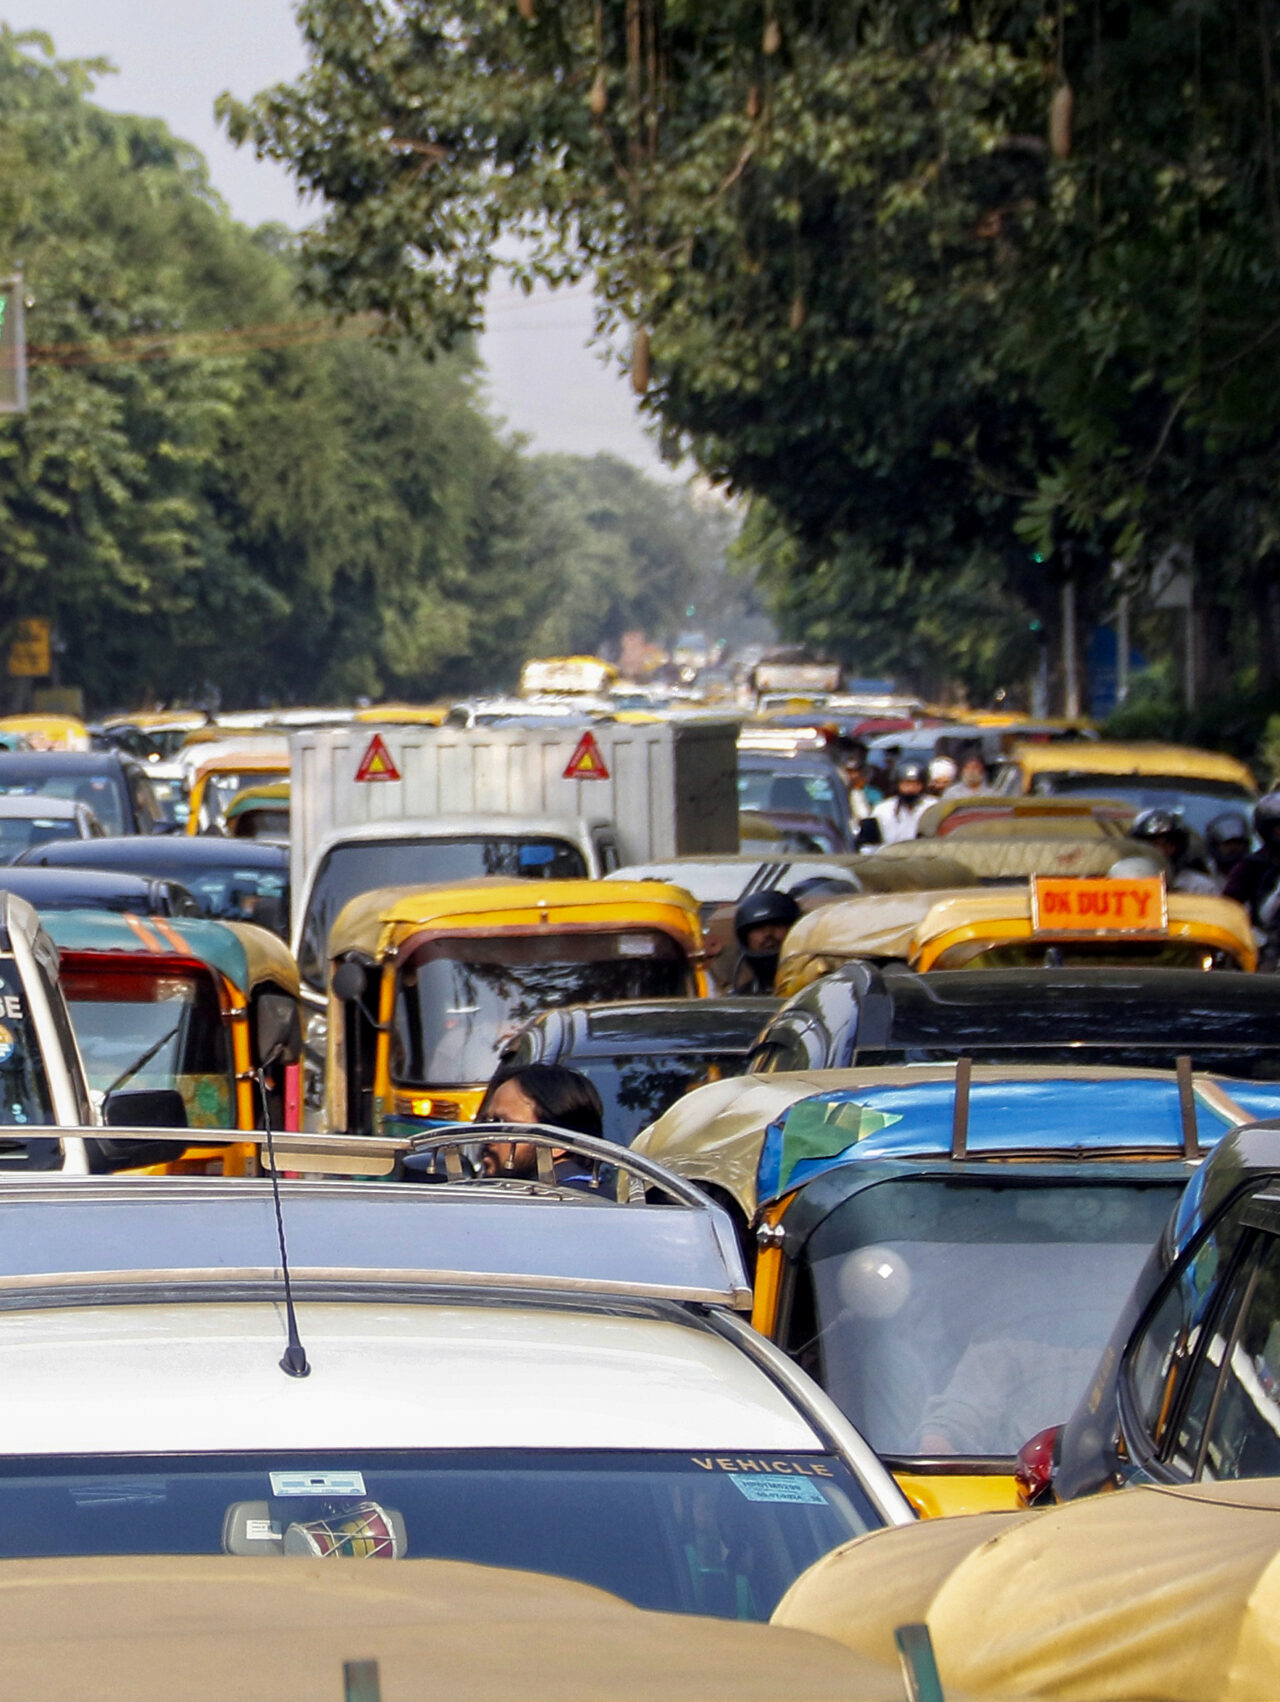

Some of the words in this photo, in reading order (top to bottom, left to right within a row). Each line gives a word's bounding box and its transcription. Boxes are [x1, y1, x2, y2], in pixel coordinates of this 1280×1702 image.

[1044, 891, 1071, 914] ON
[1077, 890, 1152, 917] DUTY
[691, 1458, 834, 1477] VEHICLE
